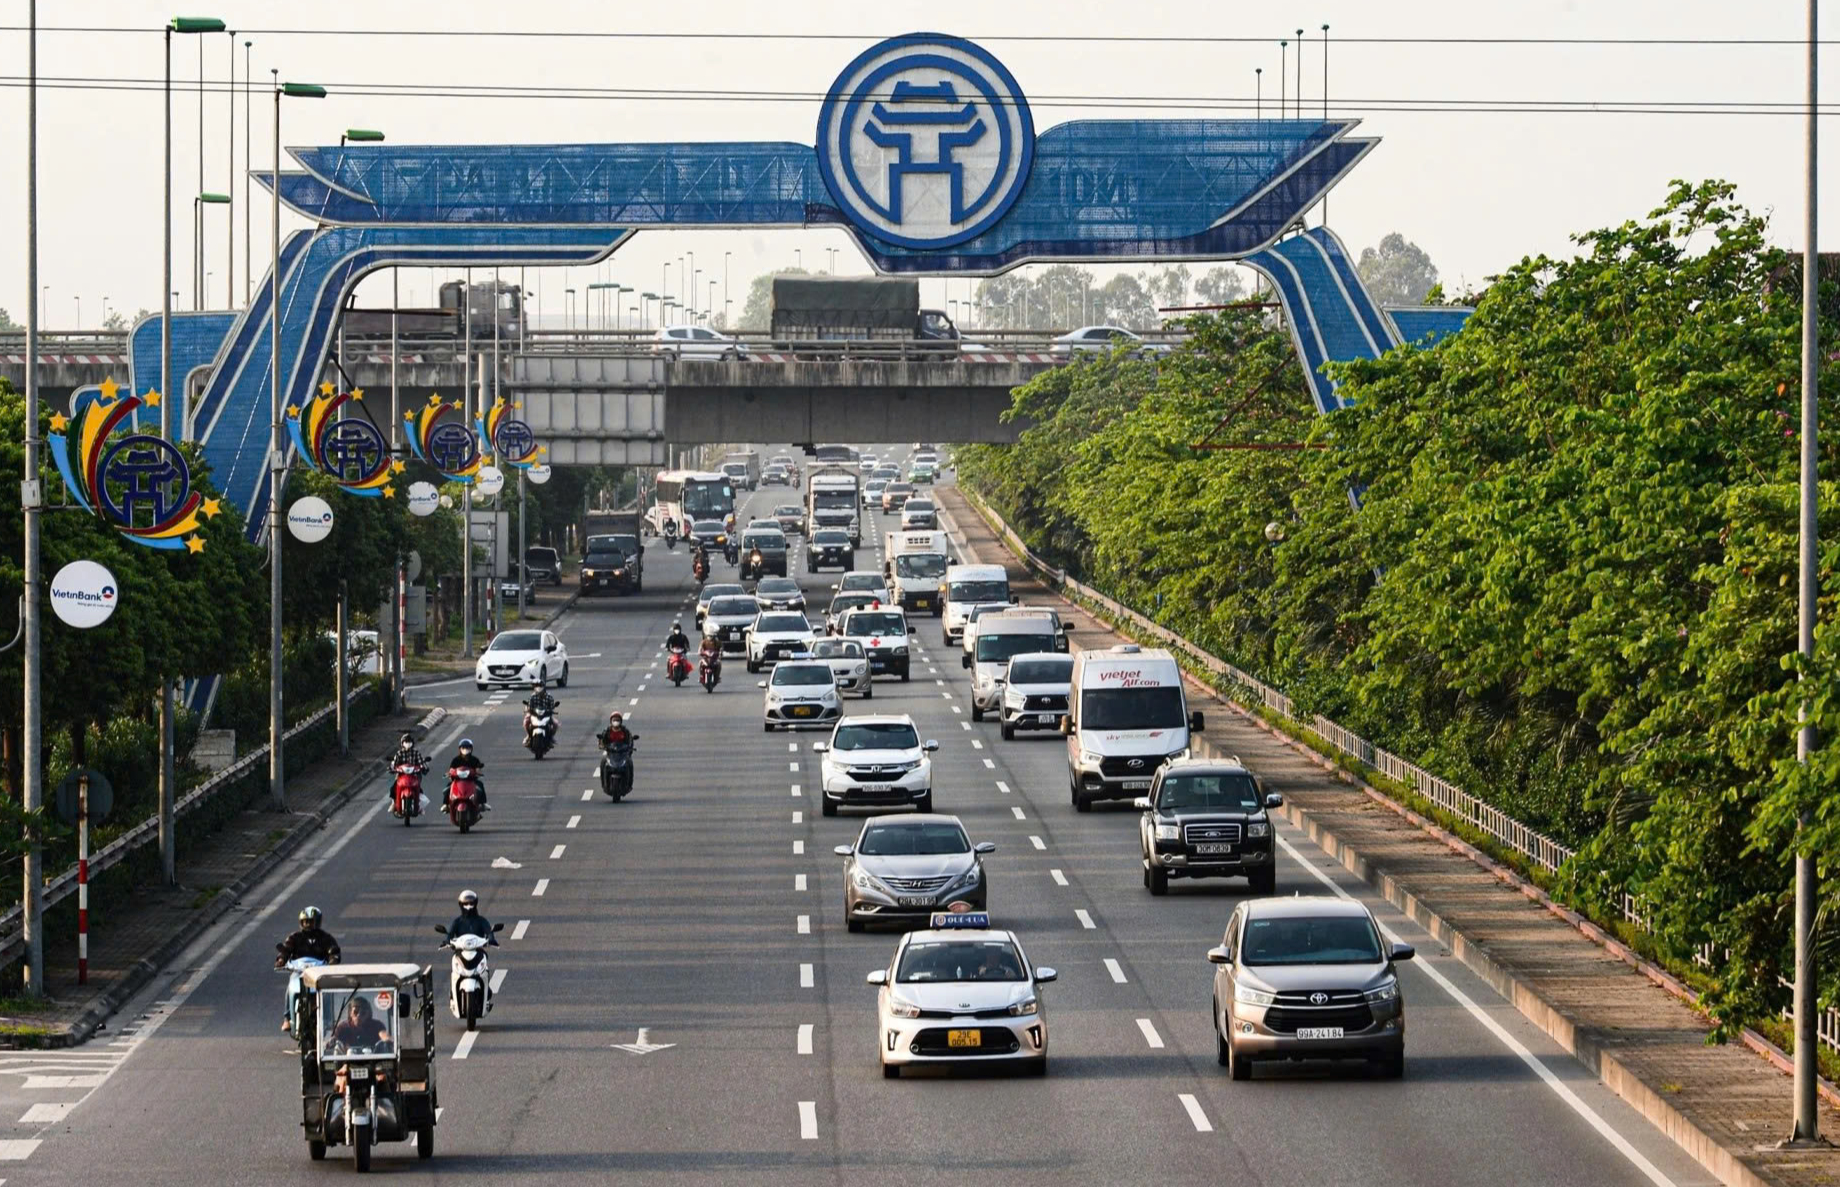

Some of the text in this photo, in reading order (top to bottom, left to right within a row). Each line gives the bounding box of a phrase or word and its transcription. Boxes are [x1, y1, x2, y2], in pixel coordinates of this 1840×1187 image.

[289, 515, 322, 524] VietinBank
[52, 588, 102, 602] VietinBank
[1122, 679, 1160, 688] Air.com
